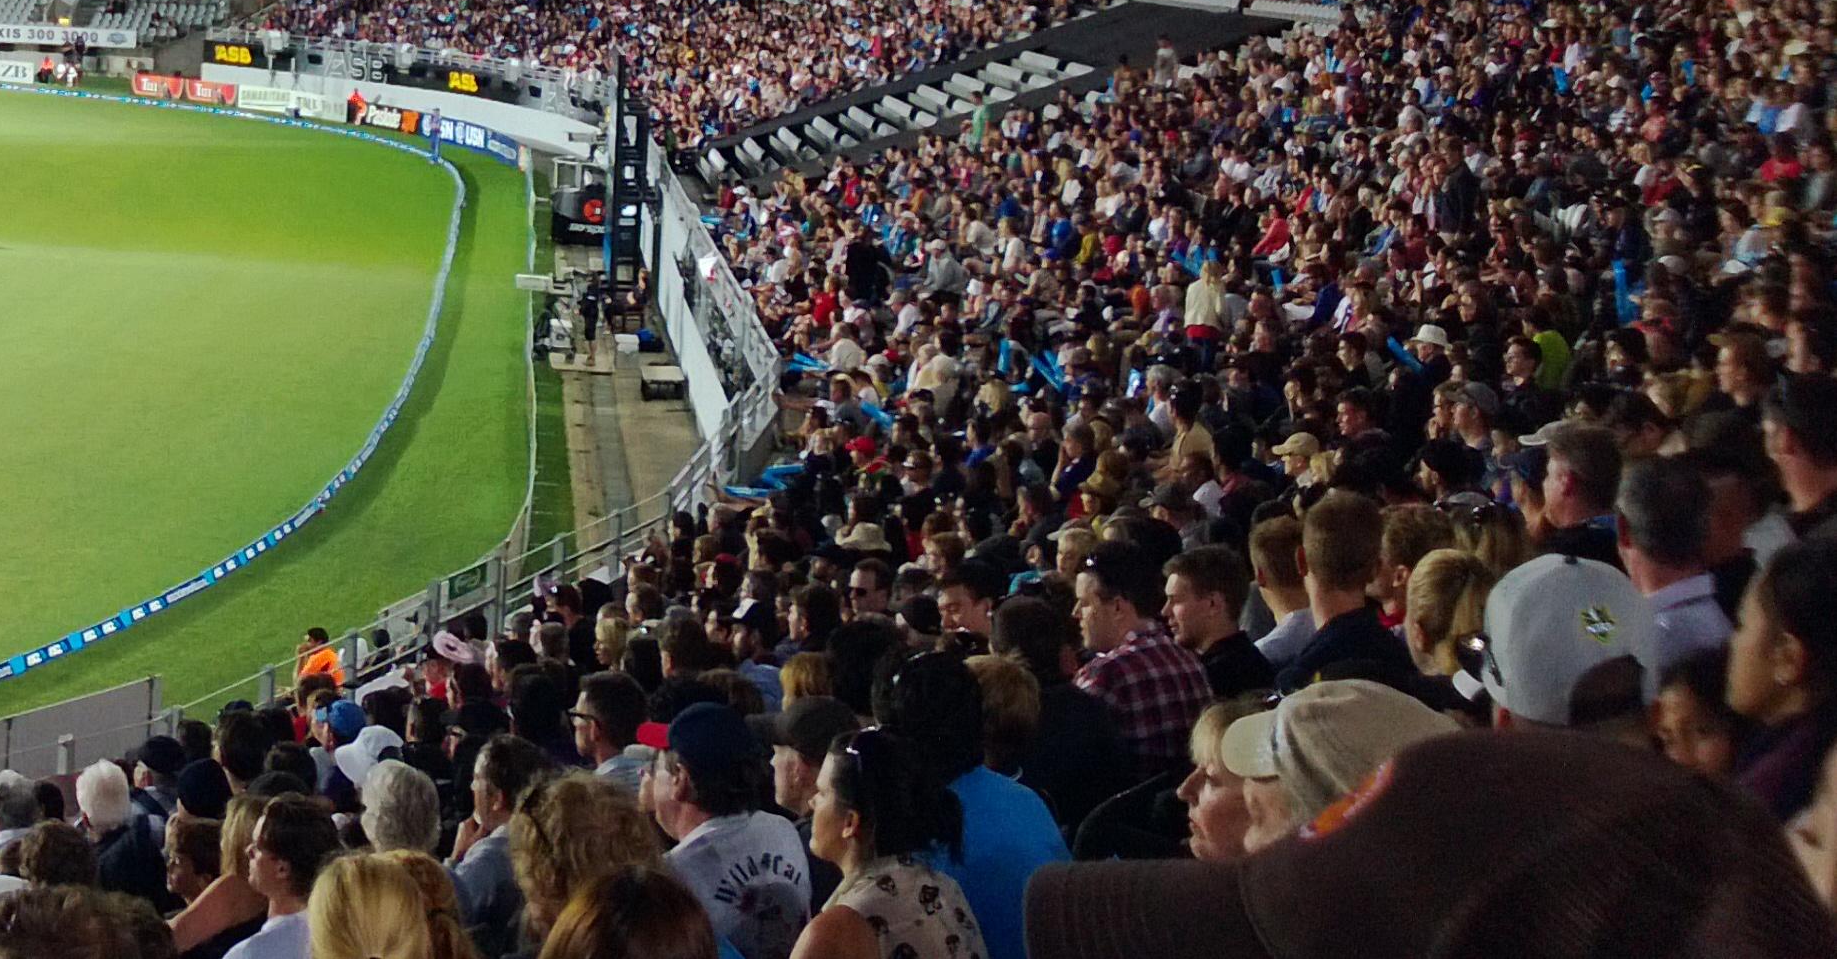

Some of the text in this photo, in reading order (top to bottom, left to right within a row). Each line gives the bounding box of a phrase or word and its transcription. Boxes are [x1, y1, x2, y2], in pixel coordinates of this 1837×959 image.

[28, 28, 55, 41] 300
[61, 29, 99, 43] 3000
[215, 45, 253, 65] ASB
[1, 62, 28, 79] ZB
